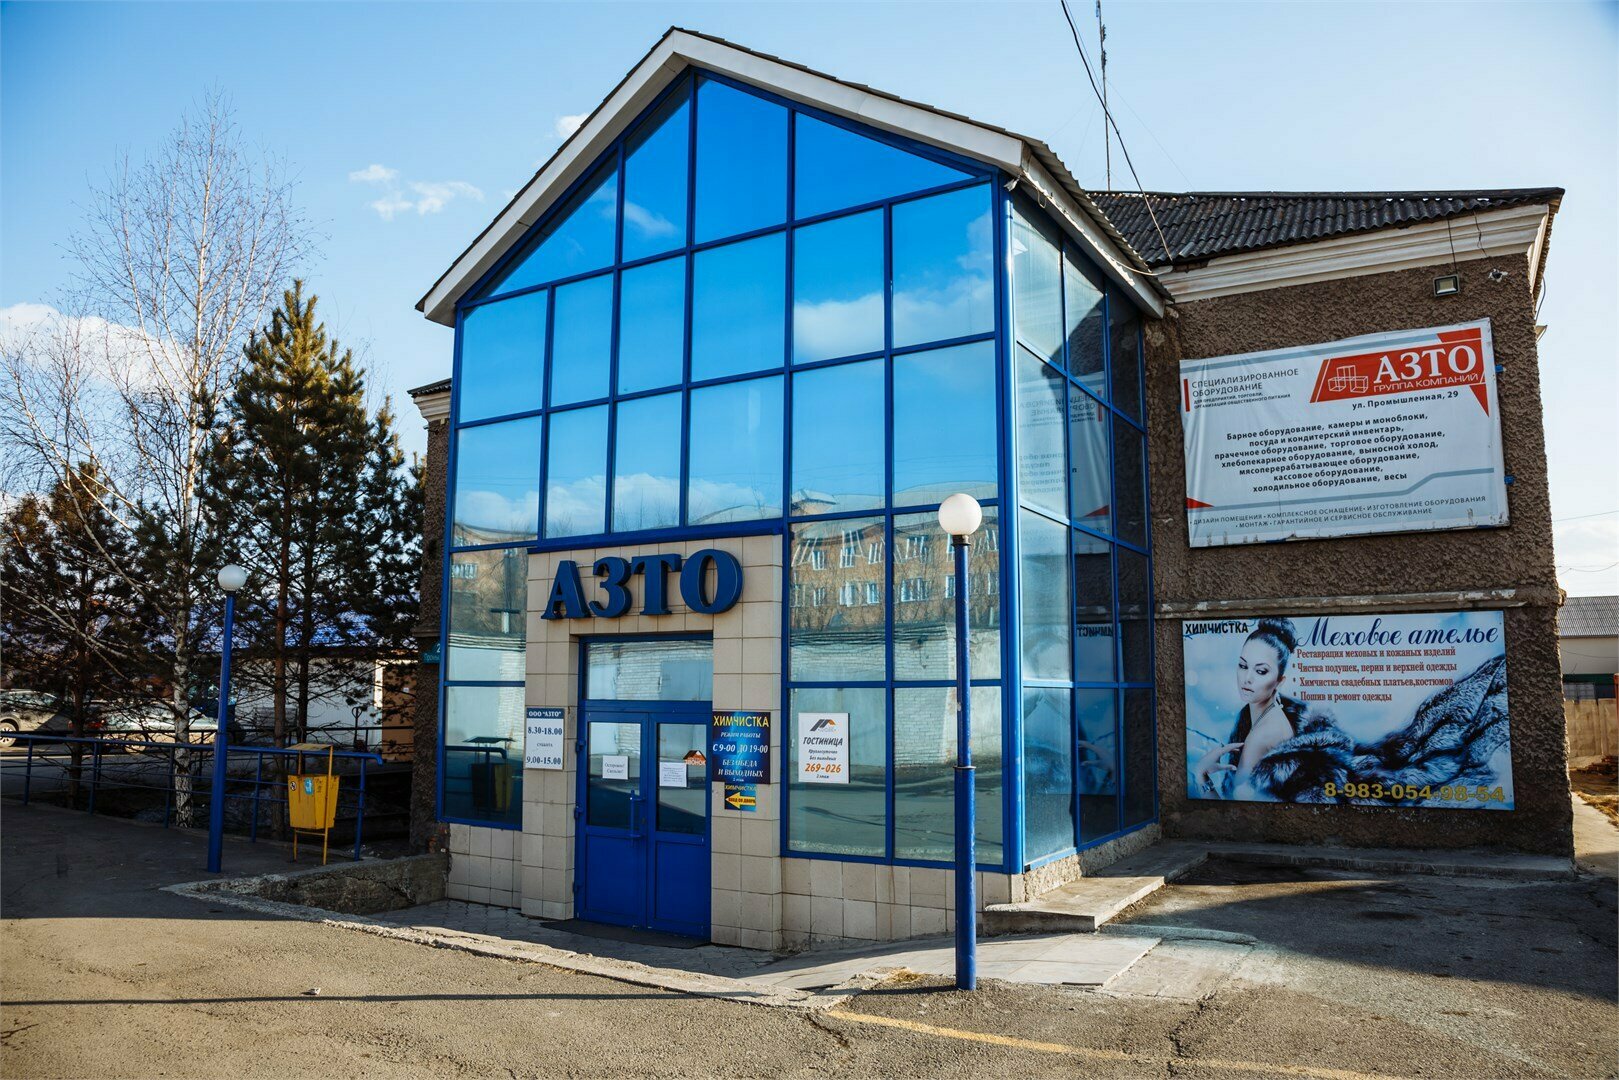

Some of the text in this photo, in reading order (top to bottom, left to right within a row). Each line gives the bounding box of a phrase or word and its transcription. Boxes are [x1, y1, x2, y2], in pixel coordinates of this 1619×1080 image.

[1373, 345, 1477, 384] АЗТО
[1192, 369, 1299, 389] СПЕЦИАЛИЗИРОВАННОЕ
[1374, 373, 1479, 392] ГРУППА КОМПАНИЙ
[1192, 383, 1263, 397] ОБОРУДОВАНИЕ
[1352, 402, 1366, 411] ул.
[1368, 393, 1445, 409] Промышленная,
[1227, 432, 1257, 441] Барное
[1259, 424, 1325, 436] оборудование,
[1328, 420, 1363, 429] камеры
[1373, 413, 1428, 424] моноблоки,
[1249, 439, 1279, 447] посуда
[1288, 430, 1350, 443] кондитерский
[1352, 426, 1404, 436] инвентарь,
[1215, 431, 1445, 460] прачечное оборудование, торговое оборудование,
[1222, 441, 1439, 468] хлебопекарное оборудование, выносной холод,
[1239, 453, 1420, 475] мясоперерабатывающее оборудование,
[1274, 466, 1383, 481] кассовое оборудование,
[1253, 482, 1310, 493] холодильное
[1312, 476, 1381, 487] оборудование,
[1220, 514, 1262, 522] ПОМЕЩЕНИЯ
[1267, 509, 1317, 518] КОМПЛЕКСНОЕ
[1319, 506, 1363, 515] ОСНАЩЕНИЕ
[1367, 501, 1422, 511] ИЗГОТОВЛЕНИЕ
[1425, 496, 1486, 506] ОБОРУДОВАНИЯ
[1274, 517, 1322, 526] ГАРАНТИЙНОЕ
[1330, 513, 1372, 522] СЕРВИСНОЕ
[1373, 508, 1432, 518] ОБСЛУЖИВАНИЕ
[541, 549, 744, 620] АЗТО
[1185, 623, 1248, 634] ХИМЧИСТКА
[1297, 617, 1498, 647] Меховое ателье
[1297, 649, 1344, 660] Реставрация
[1345, 650, 1378, 658] меховых
[1386, 649, 1422, 658] кожаных
[1423, 646, 1456, 656] изделий
[1297, 663, 1324, 673] Чистка
[1325, 664, 1359, 675] подушек,
[1361, 664, 1384, 674] перин
[1393, 662, 1424, 673] верхней
[1426, 663, 1457, 672] одежды
[1300, 678, 1340, 687] Химчистка
[1341, 678, 1382, 687] свадебных
[1300, 693, 1326, 701] Пошив
[1334, 694, 1361, 702] ремонт
[1362, 693, 1392, 702] одежды
[713, 716, 769, 728] ХИМЧИСТКА
[528, 726, 563, 736] 8.30-18.00
[719, 744, 736, 752] 9-00
[749, 745, 768, 753] 19-00
[803, 737, 843, 747] ГОСТИНИЦА
[527, 757, 562, 765] 9.00-15.00
[805, 763, 842, 773] 269-026
[1324, 782, 1506, 803] 8-983-054-98-54
